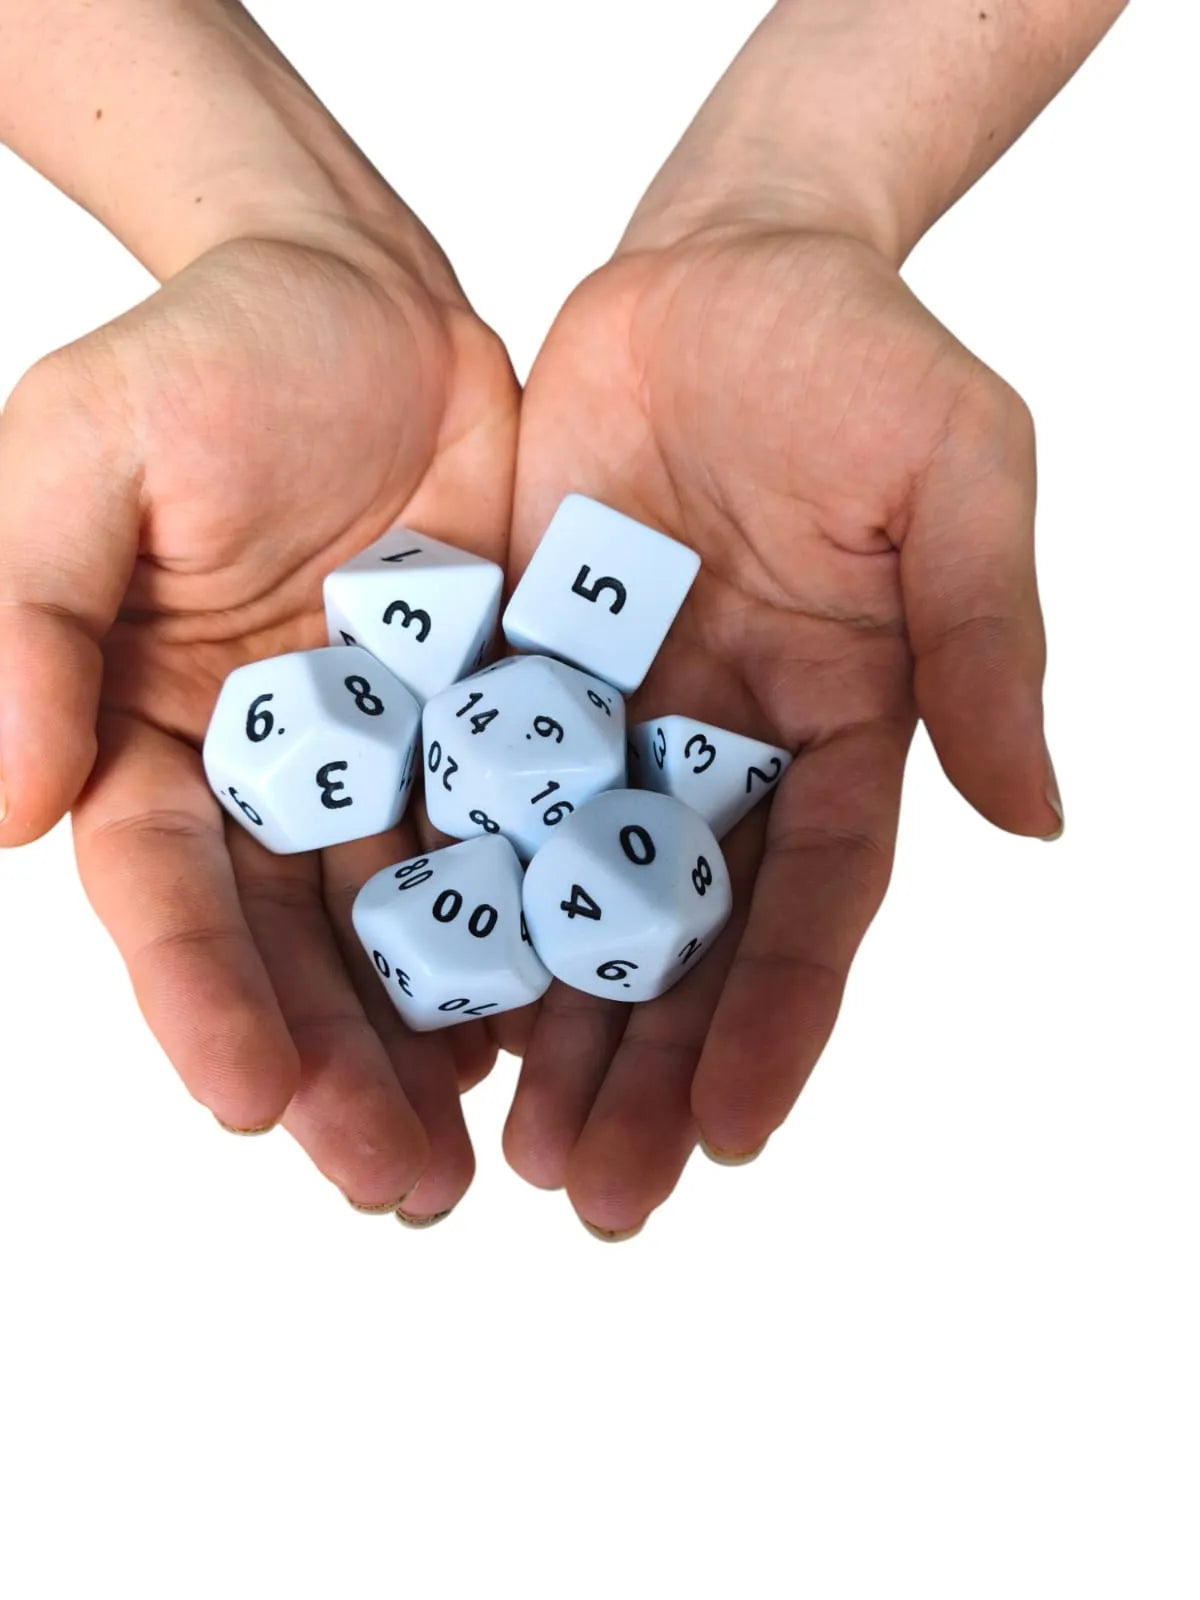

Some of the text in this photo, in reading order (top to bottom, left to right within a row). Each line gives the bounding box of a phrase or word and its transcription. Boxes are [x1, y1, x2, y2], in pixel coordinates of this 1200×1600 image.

[571, 564, 627, 615] 5
[382, 600, 432, 643] 3
[345, 675, 385, 716] 8
[456, 692, 499, 735] 14
[428, 740, 458, 791] 20
[684, 733, 717, 774] 3
[317, 761, 352, 809] 3
[746, 757, 782, 794] 2
[469, 809, 500, 835] 8
[531, 780, 575, 826] 16
[619, 824, 657, 867] 0
[395, 858, 434, 891] 80
[691, 855, 713, 897] 8
[432, 889, 498, 939] 00
[561, 884, 602, 921] 4
[373, 950, 414, 998] 30
